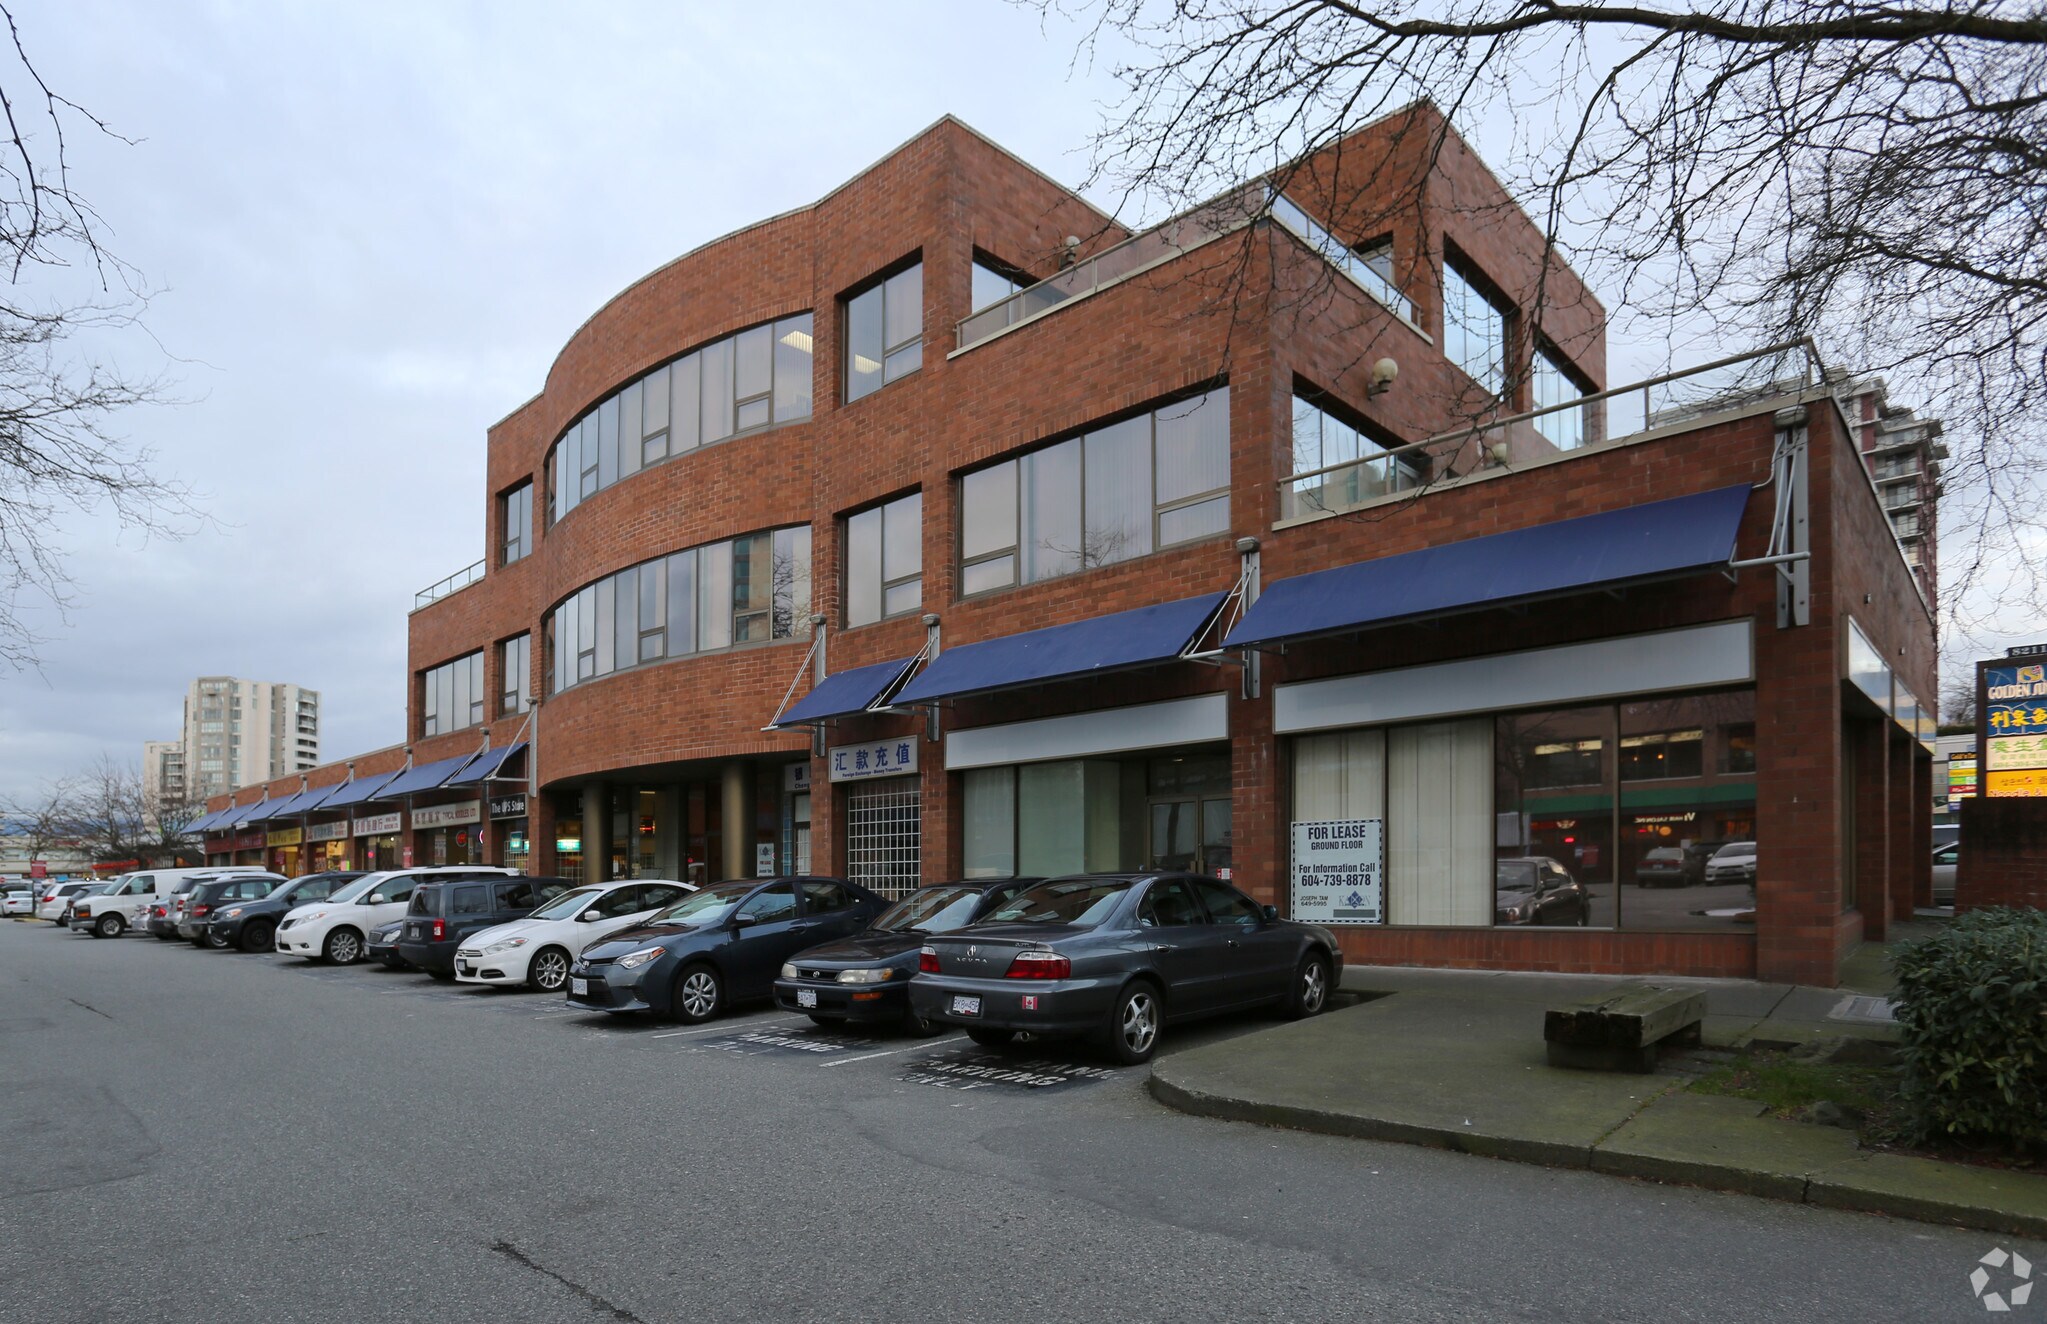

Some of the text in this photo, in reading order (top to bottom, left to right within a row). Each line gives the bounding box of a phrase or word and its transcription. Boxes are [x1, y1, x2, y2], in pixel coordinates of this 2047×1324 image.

[1988, 684, 2030, 700] GOLDEN
[835, 743, 910, 772] 汇款充值
[491, 800, 524, 813] The UPS Store
[1308, 825, 1366, 840] FOR LEASE
[1311, 840, 1363, 850] GROUND FLOOR
[1299, 863, 1375, 874] For Information Call
[1301, 874, 1371, 886] 604-739-8878
[727, 1033, 844, 1052] PARKING
[905, 1060, 1067, 1086] PARKING
